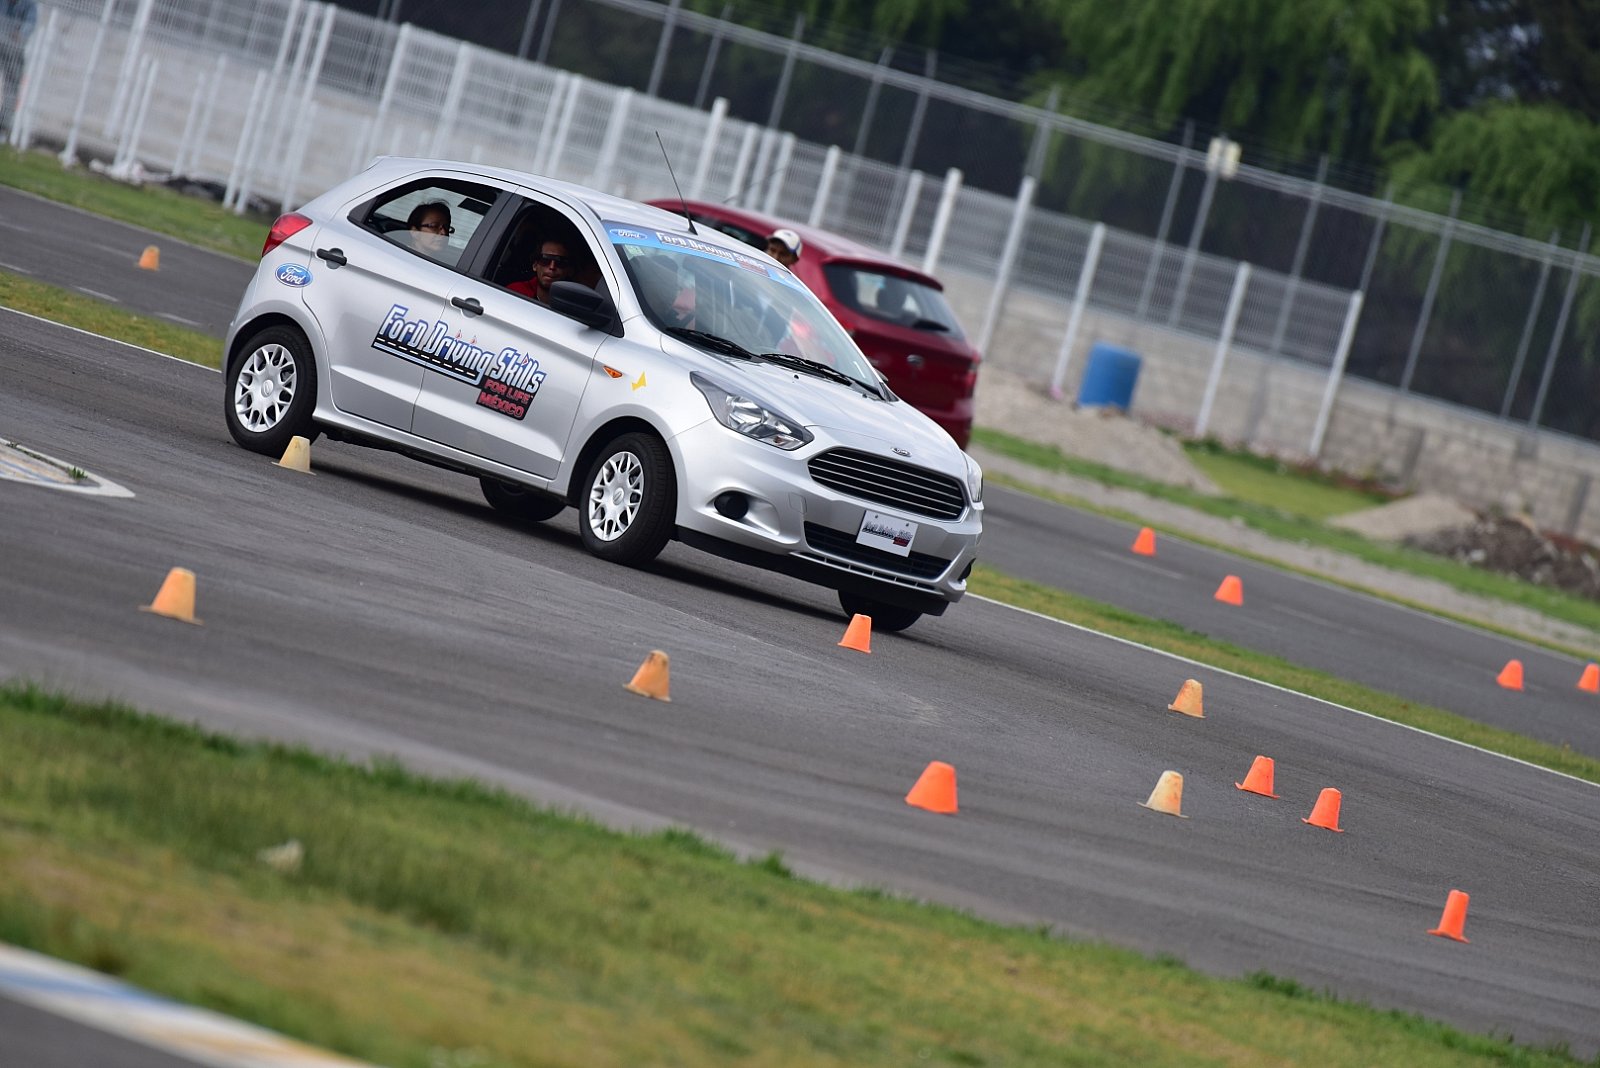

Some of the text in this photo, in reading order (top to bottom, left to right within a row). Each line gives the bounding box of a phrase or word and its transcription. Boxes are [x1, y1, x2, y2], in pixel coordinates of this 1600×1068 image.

[280, 266, 307, 285] Ford
[423, 320, 493, 384] Driving
[492, 347, 547, 393] Skills
[485, 379, 530, 404] FOR LIFE
